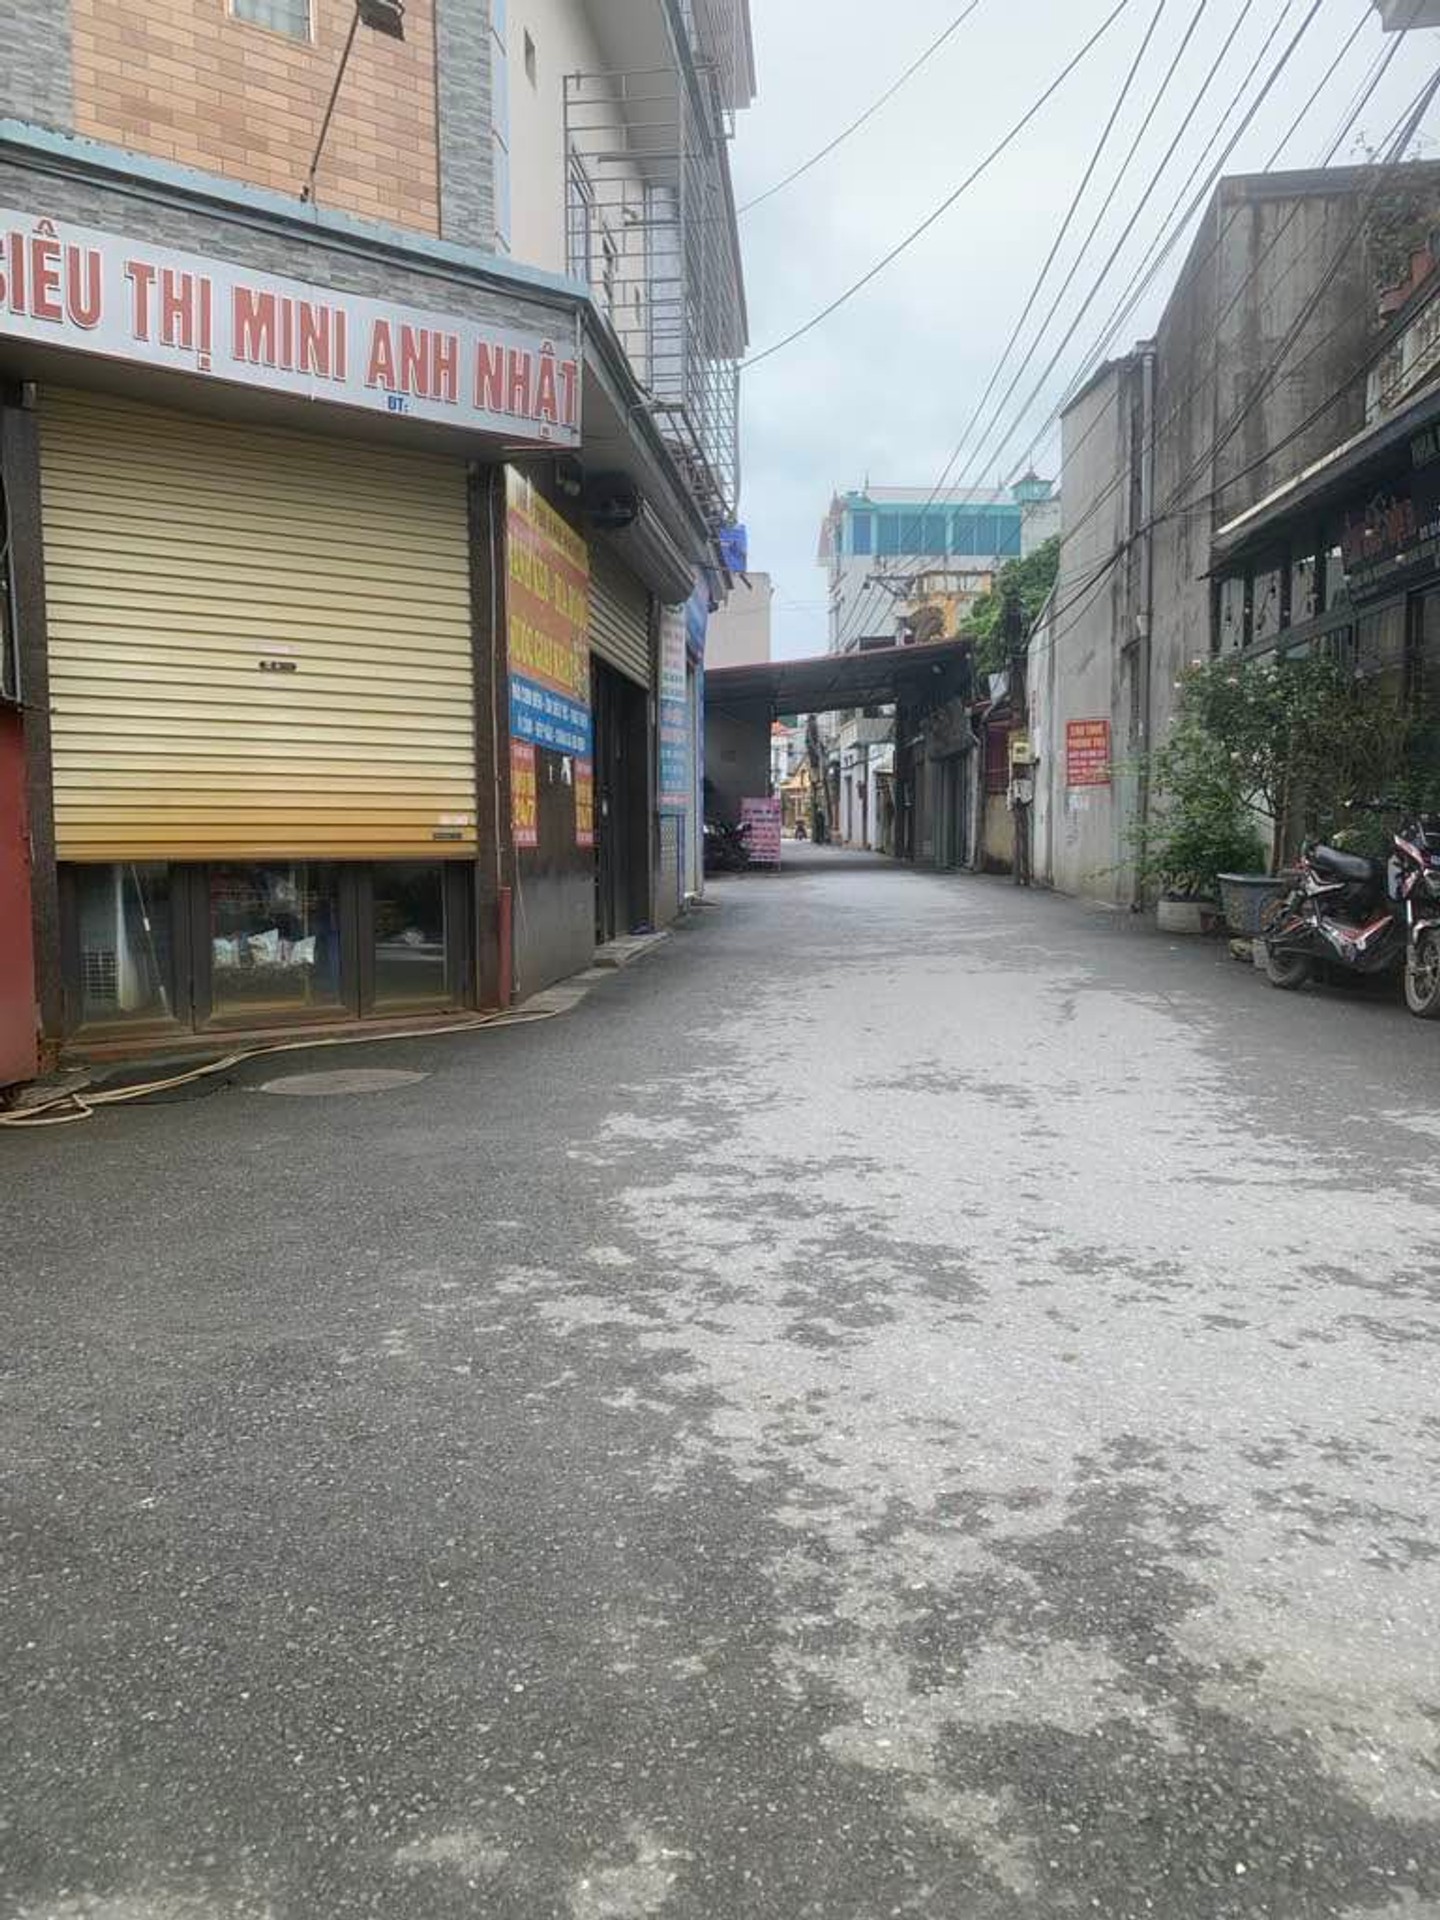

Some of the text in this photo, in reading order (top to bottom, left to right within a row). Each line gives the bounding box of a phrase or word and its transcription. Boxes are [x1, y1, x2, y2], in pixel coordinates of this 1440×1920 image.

[0, 219, 576, 439] IÊU THỊ MINI ANH NHẬT
